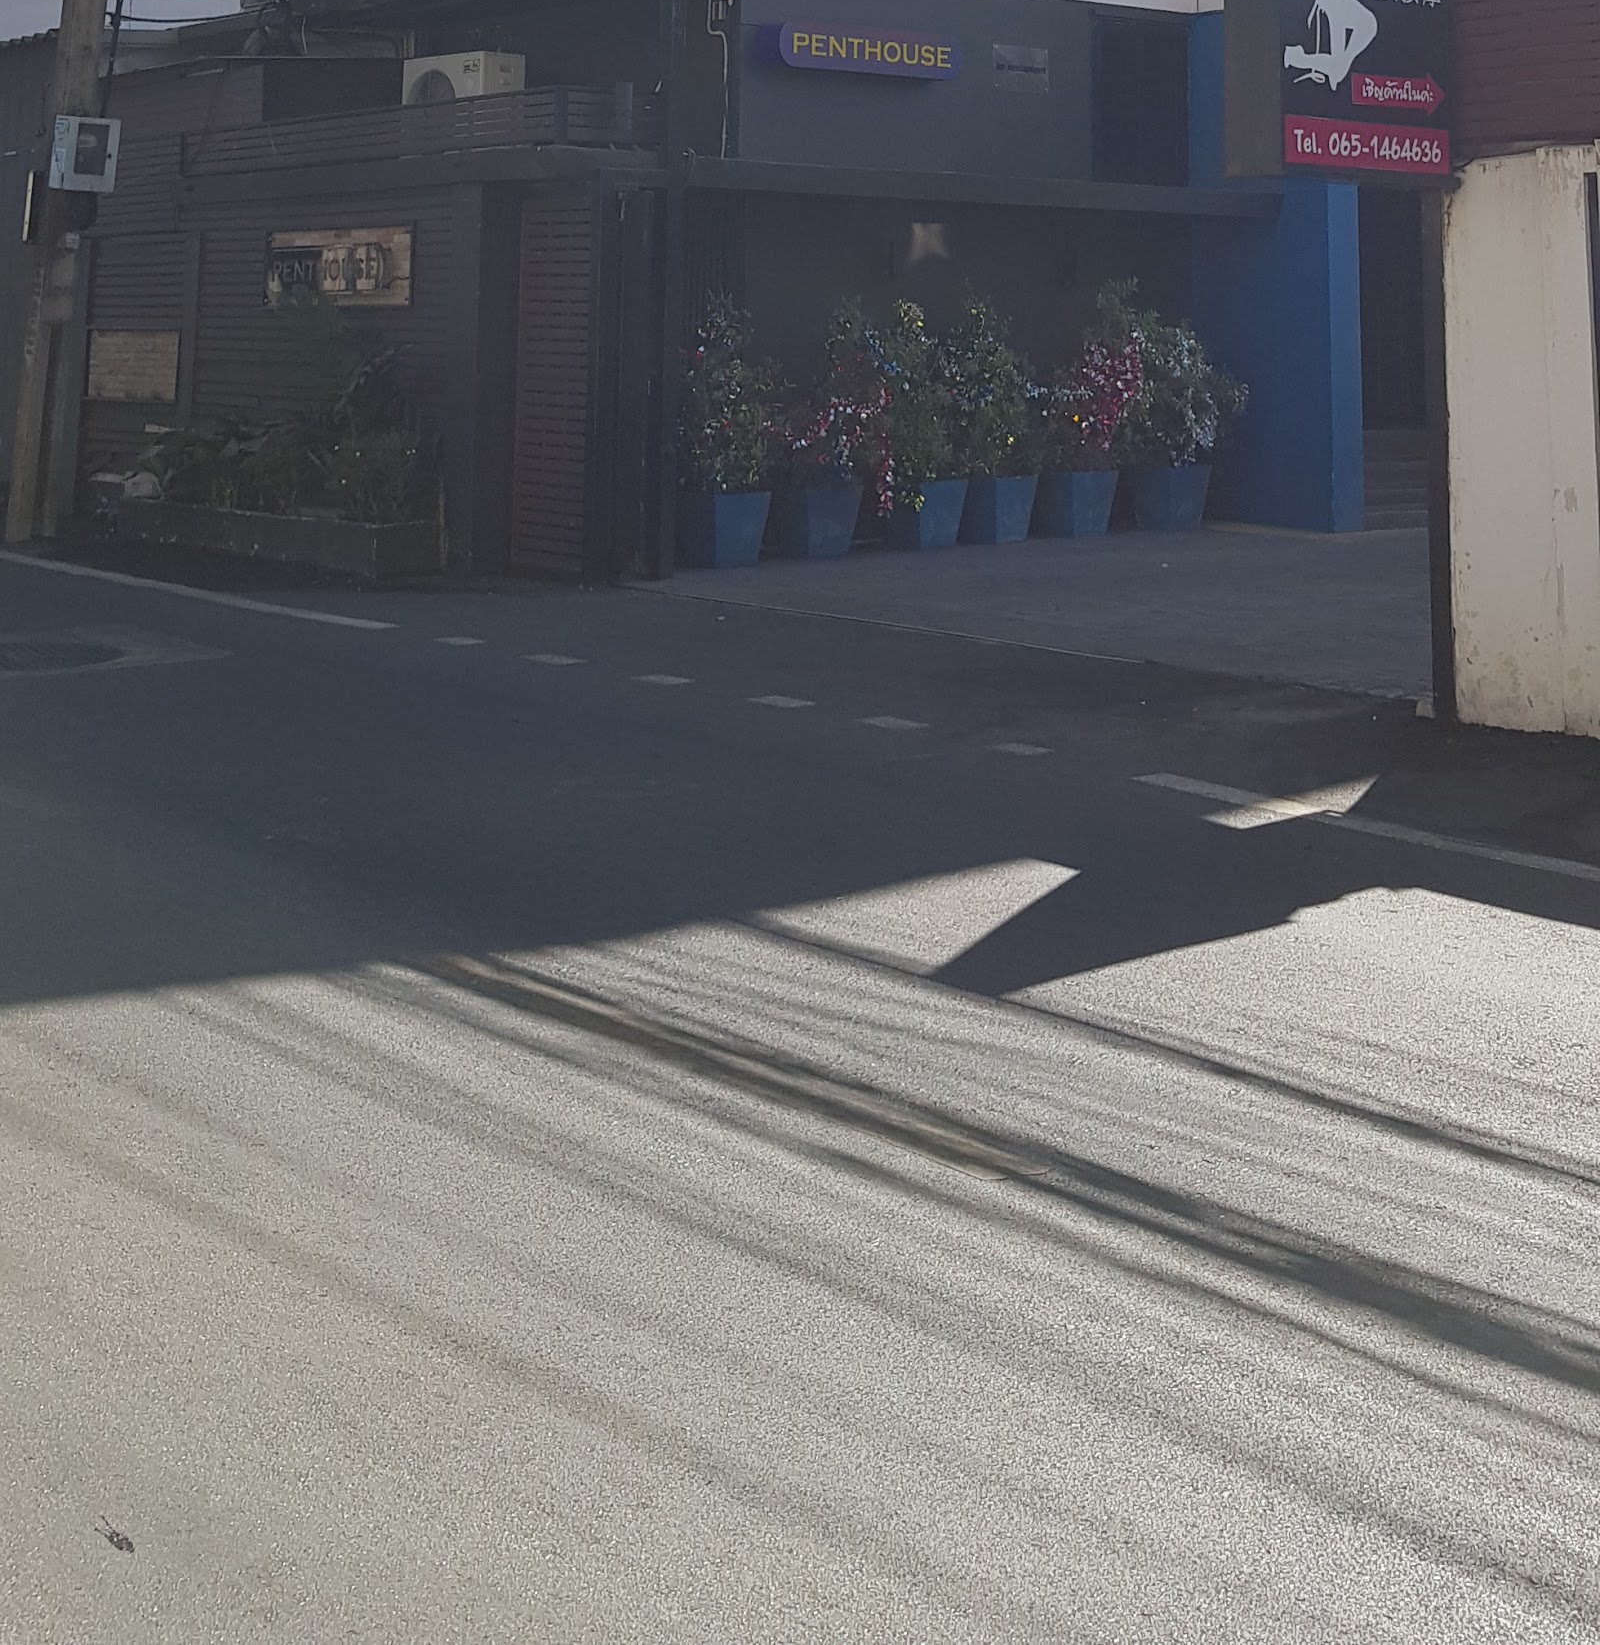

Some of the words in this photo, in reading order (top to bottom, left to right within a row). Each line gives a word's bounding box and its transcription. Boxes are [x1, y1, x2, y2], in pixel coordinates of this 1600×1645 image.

[792, 32, 952, 68] PENTHOUSE
[1293, 128, 1323, 155] Tel.
[1328, 131, 1442, 164] 065-1464636
